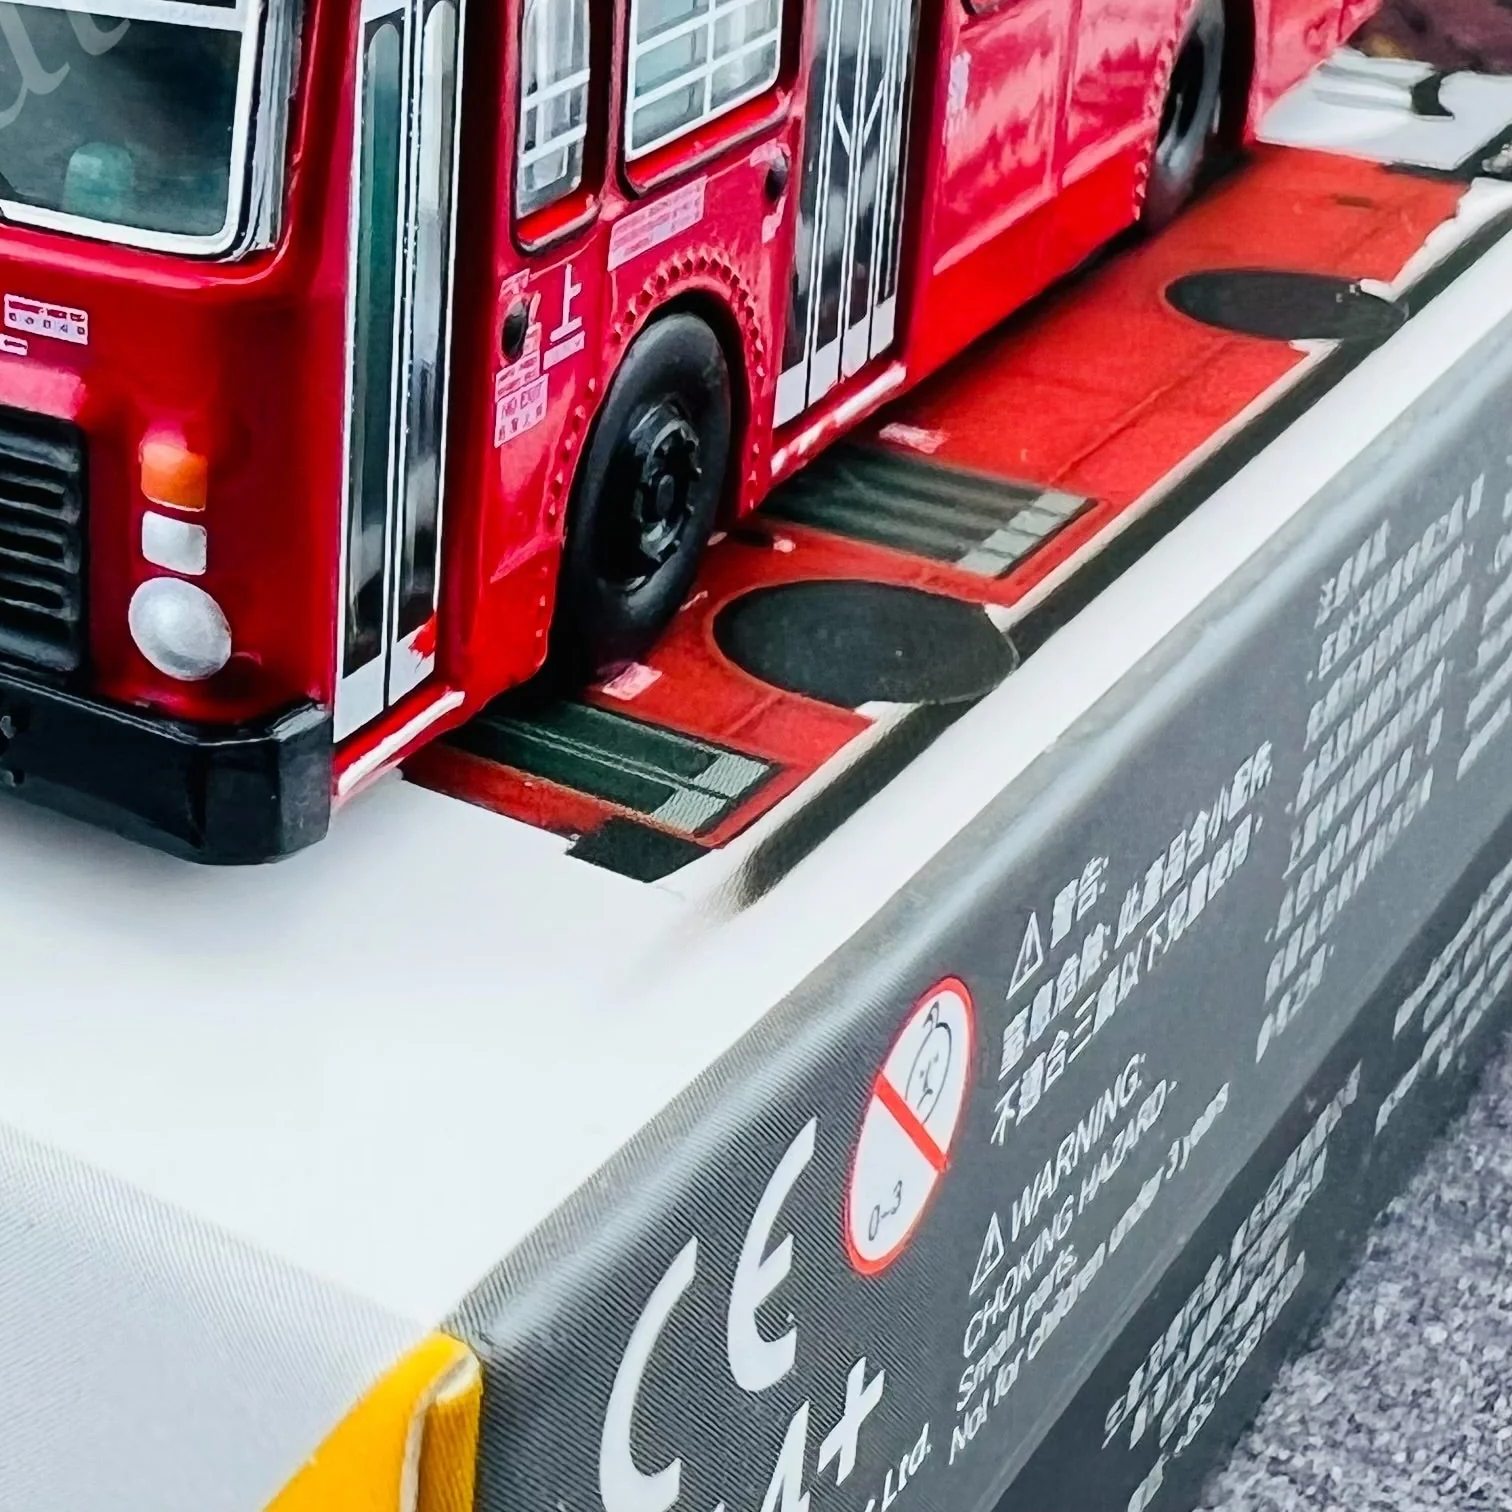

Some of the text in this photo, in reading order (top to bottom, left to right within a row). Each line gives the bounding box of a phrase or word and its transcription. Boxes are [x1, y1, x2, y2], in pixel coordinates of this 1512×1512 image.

[550, 264, 582, 342] 上
[1011, 1052, 1147, 1242] WARNING:
[868, 1180, 903, 1241] 0-3
[963, 1194, 1075, 1359] CHOKING
[948, 1387, 991, 1466] Not
[992, 1347, 1025, 1407] for
[955, 1304, 1020, 1412] Small
[882, 1421, 932, 1512] Ltd.
